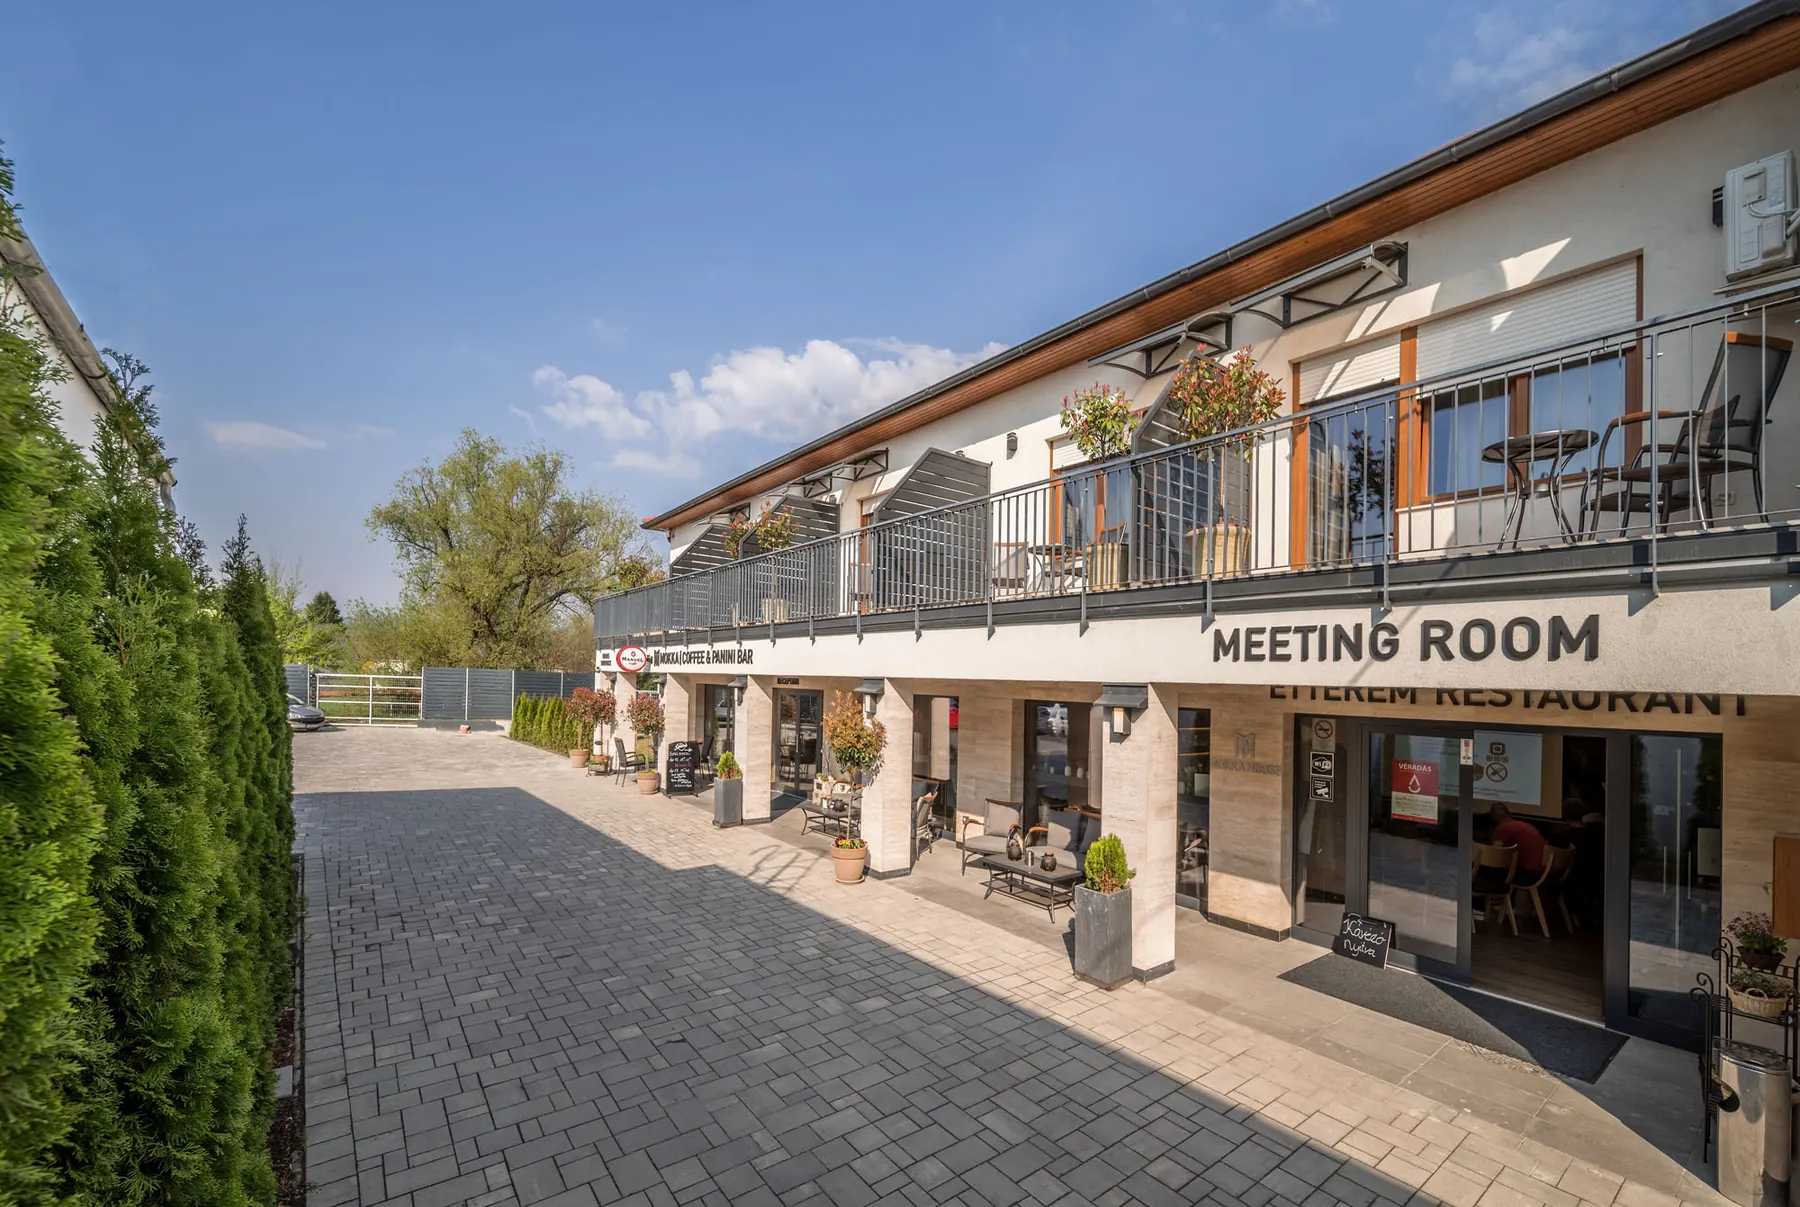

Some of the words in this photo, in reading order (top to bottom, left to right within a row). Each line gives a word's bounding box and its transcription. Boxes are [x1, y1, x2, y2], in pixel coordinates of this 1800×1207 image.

[1212, 622, 1400, 663] MEETING
[1420, 614, 1600, 663] ROOM
[682, 650, 705, 664] COFFEE
[705, 650, 711, 664] &
[712, 649, 736, 664] PANINI
[737, 649, 753, 665] BAR
[1398, 762, 1432, 773] VÉRADÁS
